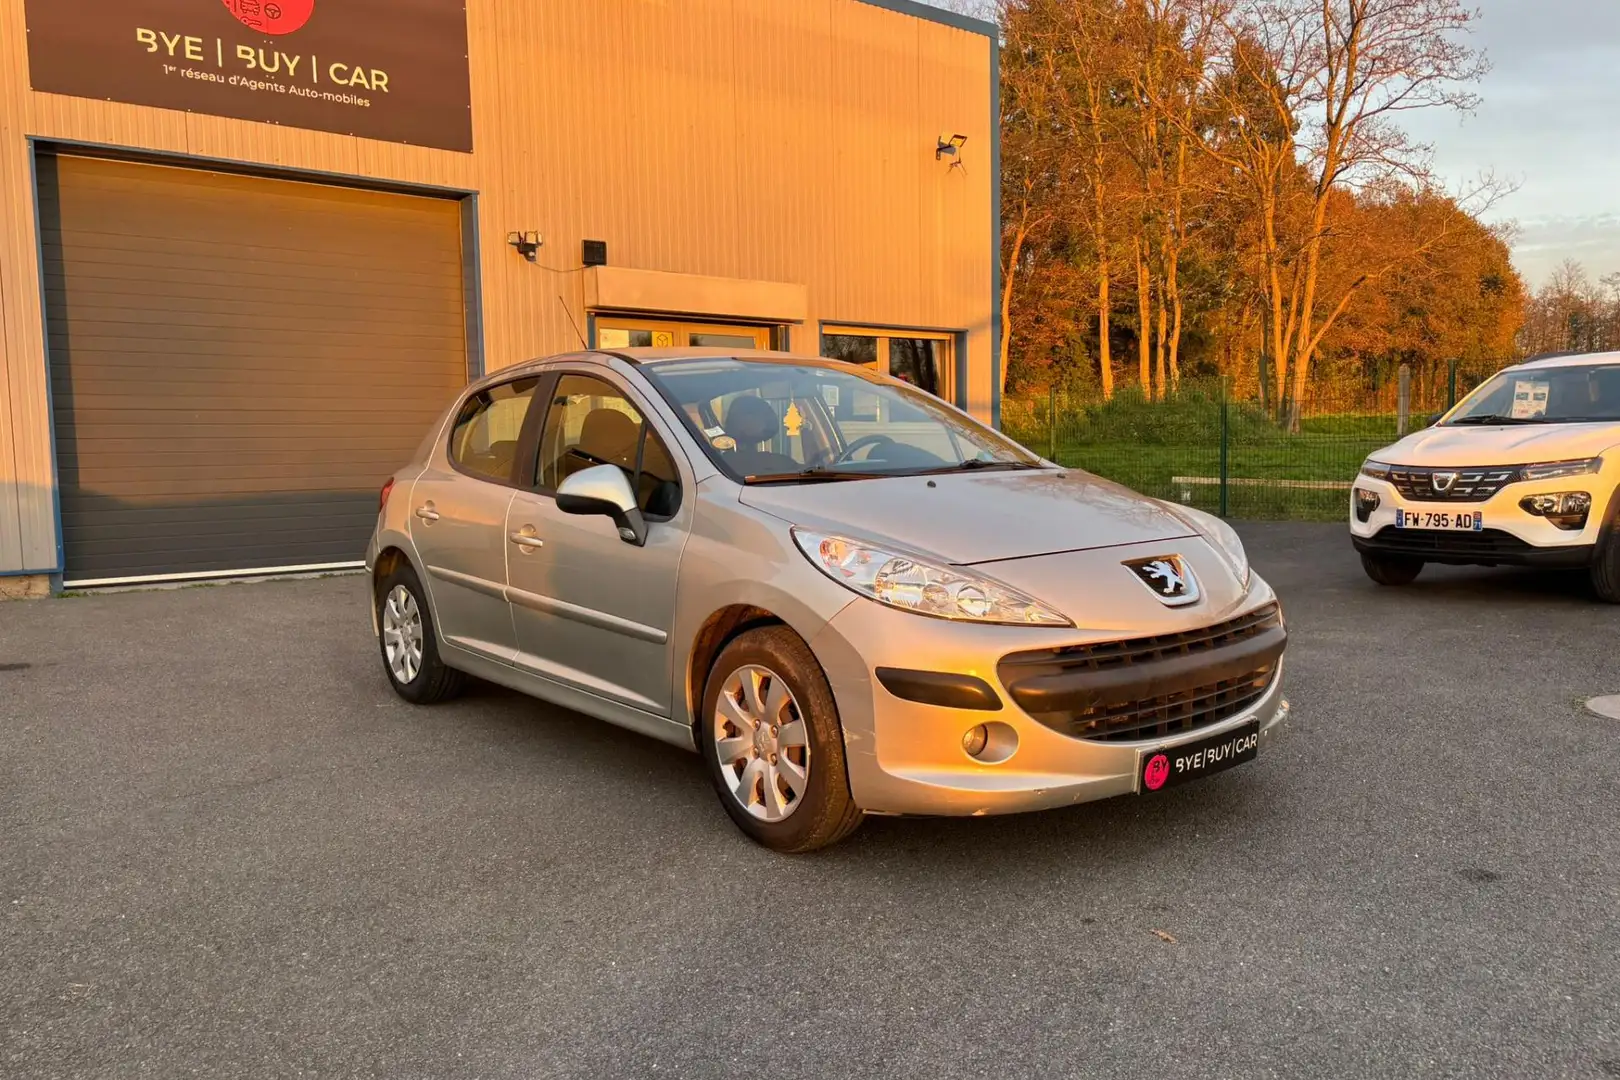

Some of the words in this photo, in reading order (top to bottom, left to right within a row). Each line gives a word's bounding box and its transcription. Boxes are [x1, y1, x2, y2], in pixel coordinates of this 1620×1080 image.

[136, 27, 204, 61] BYE
[236, 44, 301, 77] BUY
[328, 62, 389, 93] CAR
[180, 68, 225, 83] réseau
[288, 85, 371, 107] Auto-mobiles
[1404, 512, 1472, 528] FW-795-AD
